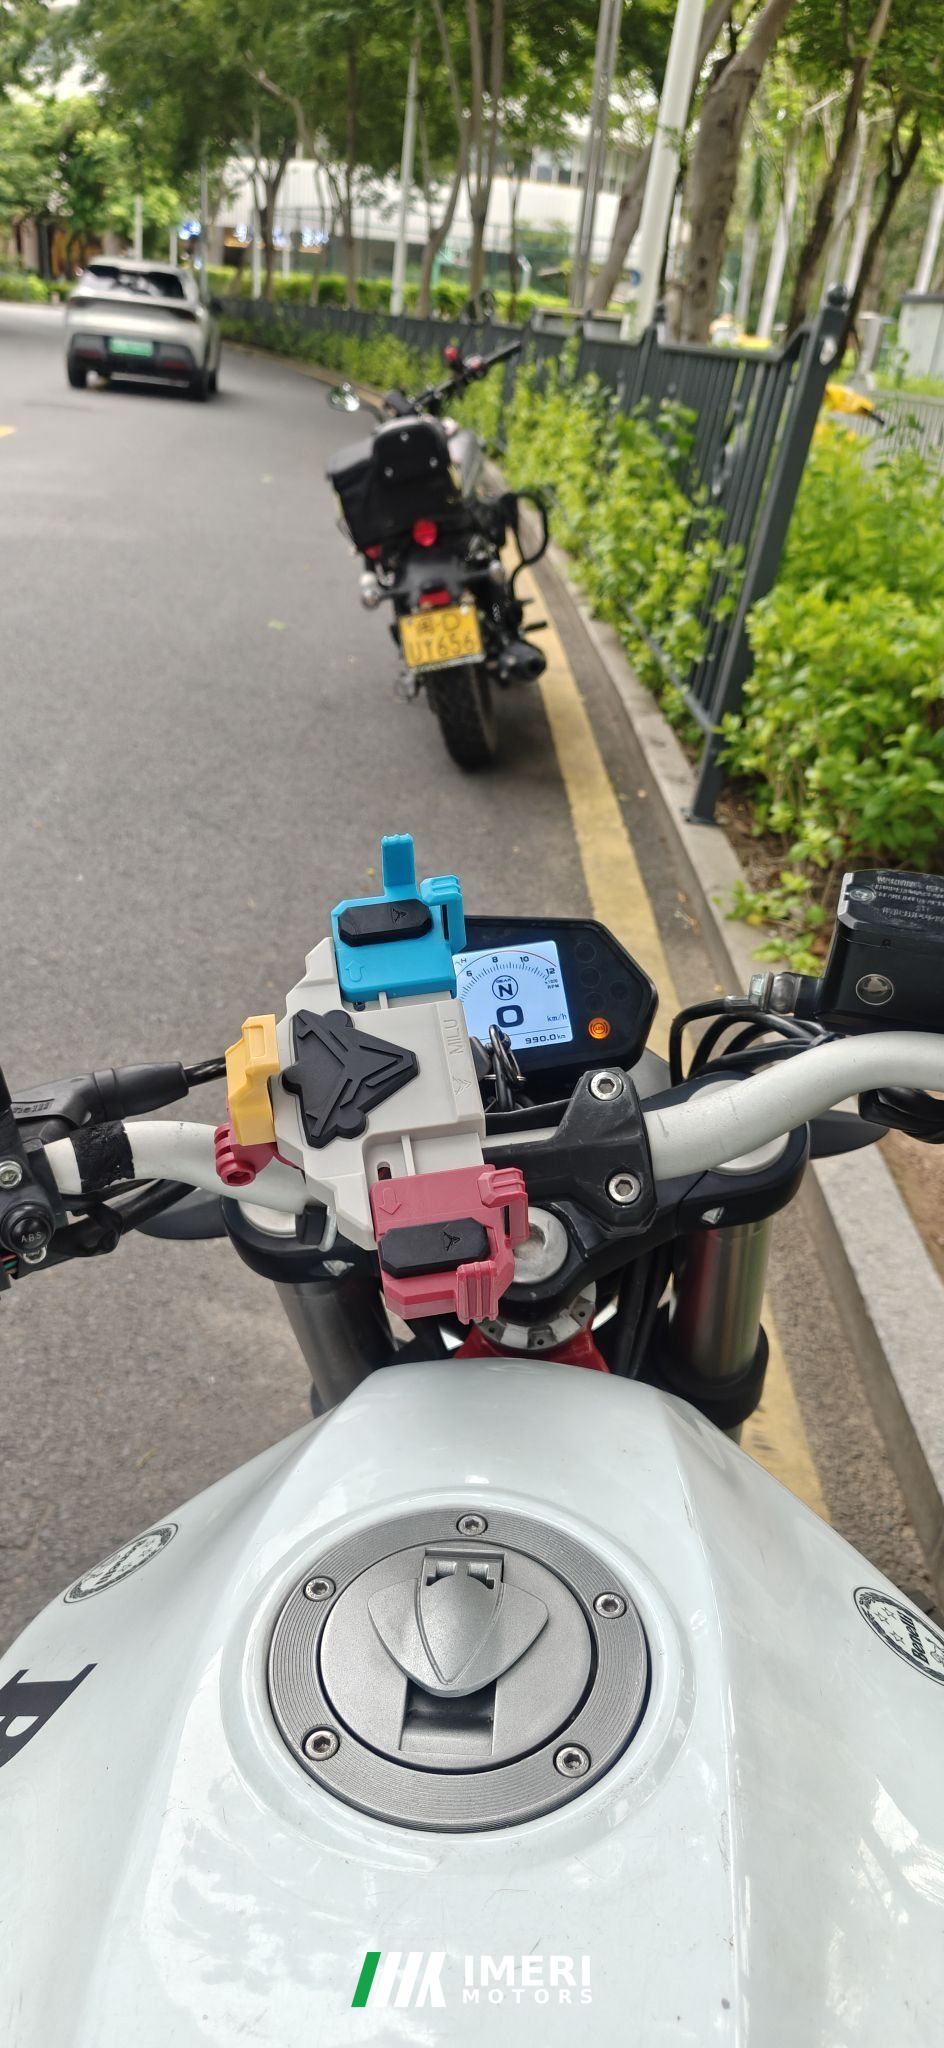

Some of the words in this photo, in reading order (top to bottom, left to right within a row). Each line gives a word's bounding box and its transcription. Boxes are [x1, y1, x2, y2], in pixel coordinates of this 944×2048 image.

[498, 983, 514, 997] N
[546, 1012, 568, 1022] km/h
[443, 1019, 465, 1054] MILU
[21, 1231, 42, 1243] ABS
[896, 1610, 931, 1666] Benelli
